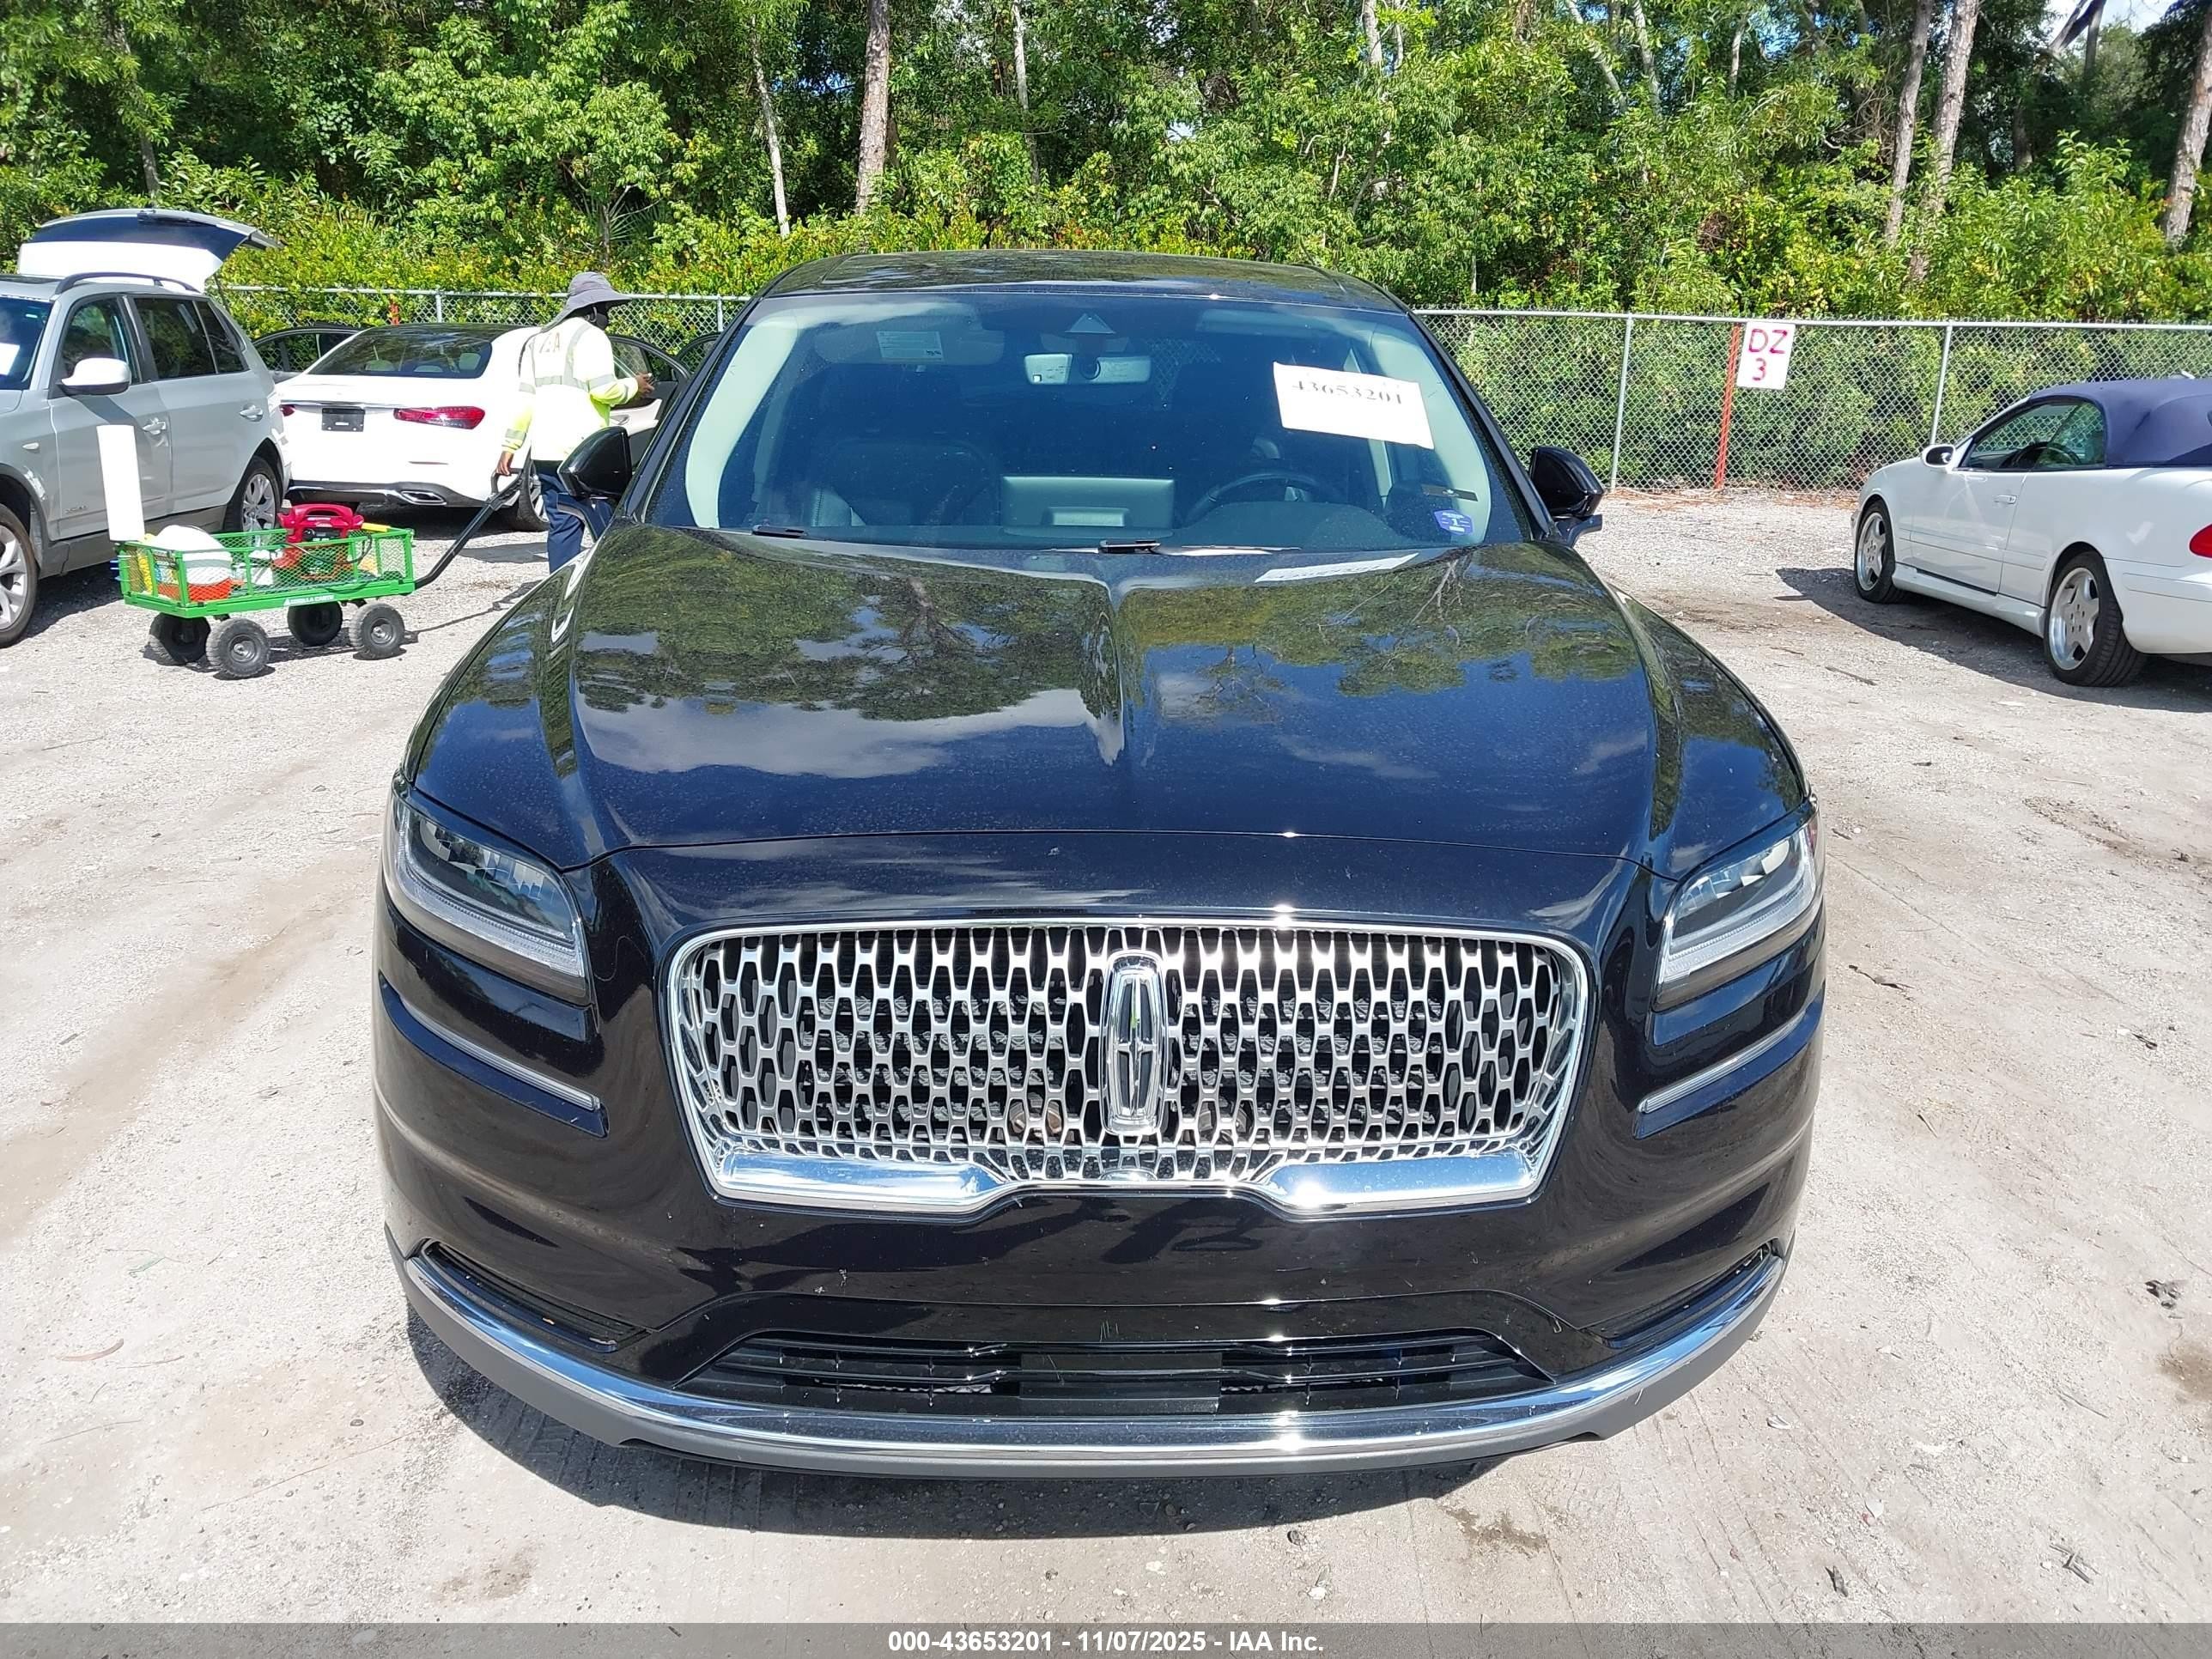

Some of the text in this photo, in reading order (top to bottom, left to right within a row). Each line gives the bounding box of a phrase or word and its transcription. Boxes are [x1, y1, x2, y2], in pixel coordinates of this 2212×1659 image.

[1748, 328, 1788, 355] DZ
[1753, 357, 1767, 381] 3
[1291, 380, 1402, 404] 43653201
